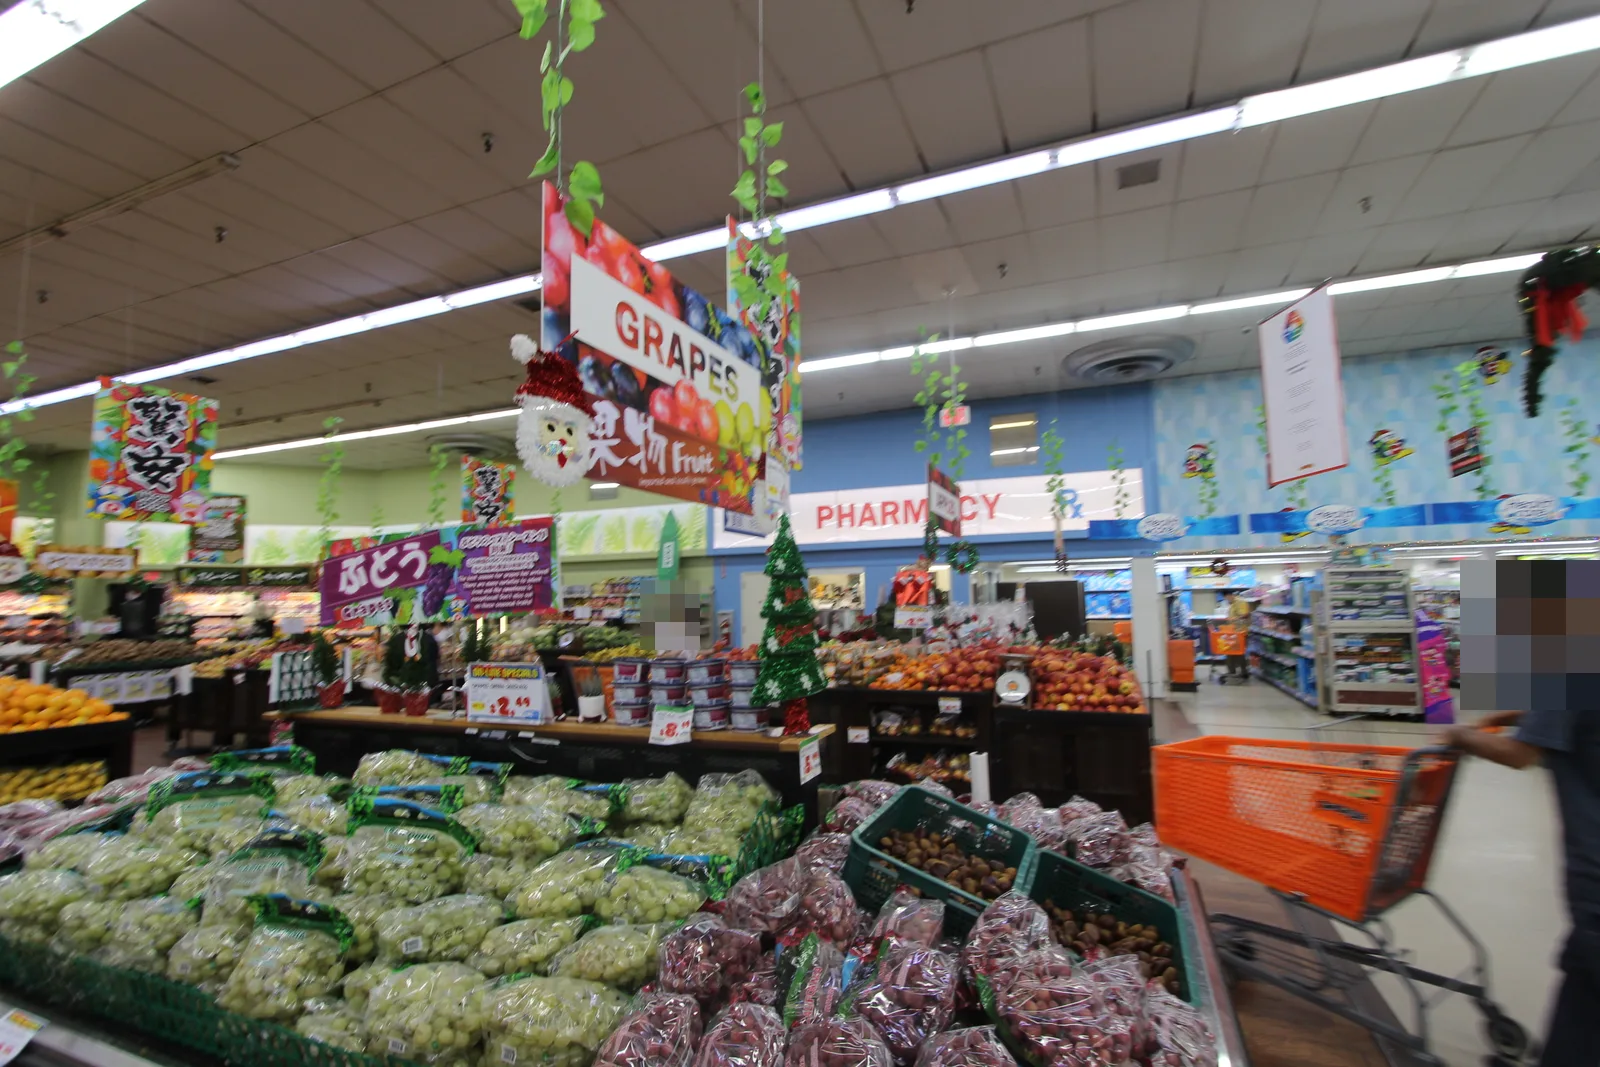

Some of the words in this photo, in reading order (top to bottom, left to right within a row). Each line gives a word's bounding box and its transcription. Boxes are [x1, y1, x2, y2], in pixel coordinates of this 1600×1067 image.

[615, 301, 739, 401] GRAPES
[672, 441, 715, 475] Fruit
[816, 493, 1003, 529] PHARMCY
[338, 541, 428, 595] ぶどう
[340, 597, 394, 621] Grapes
